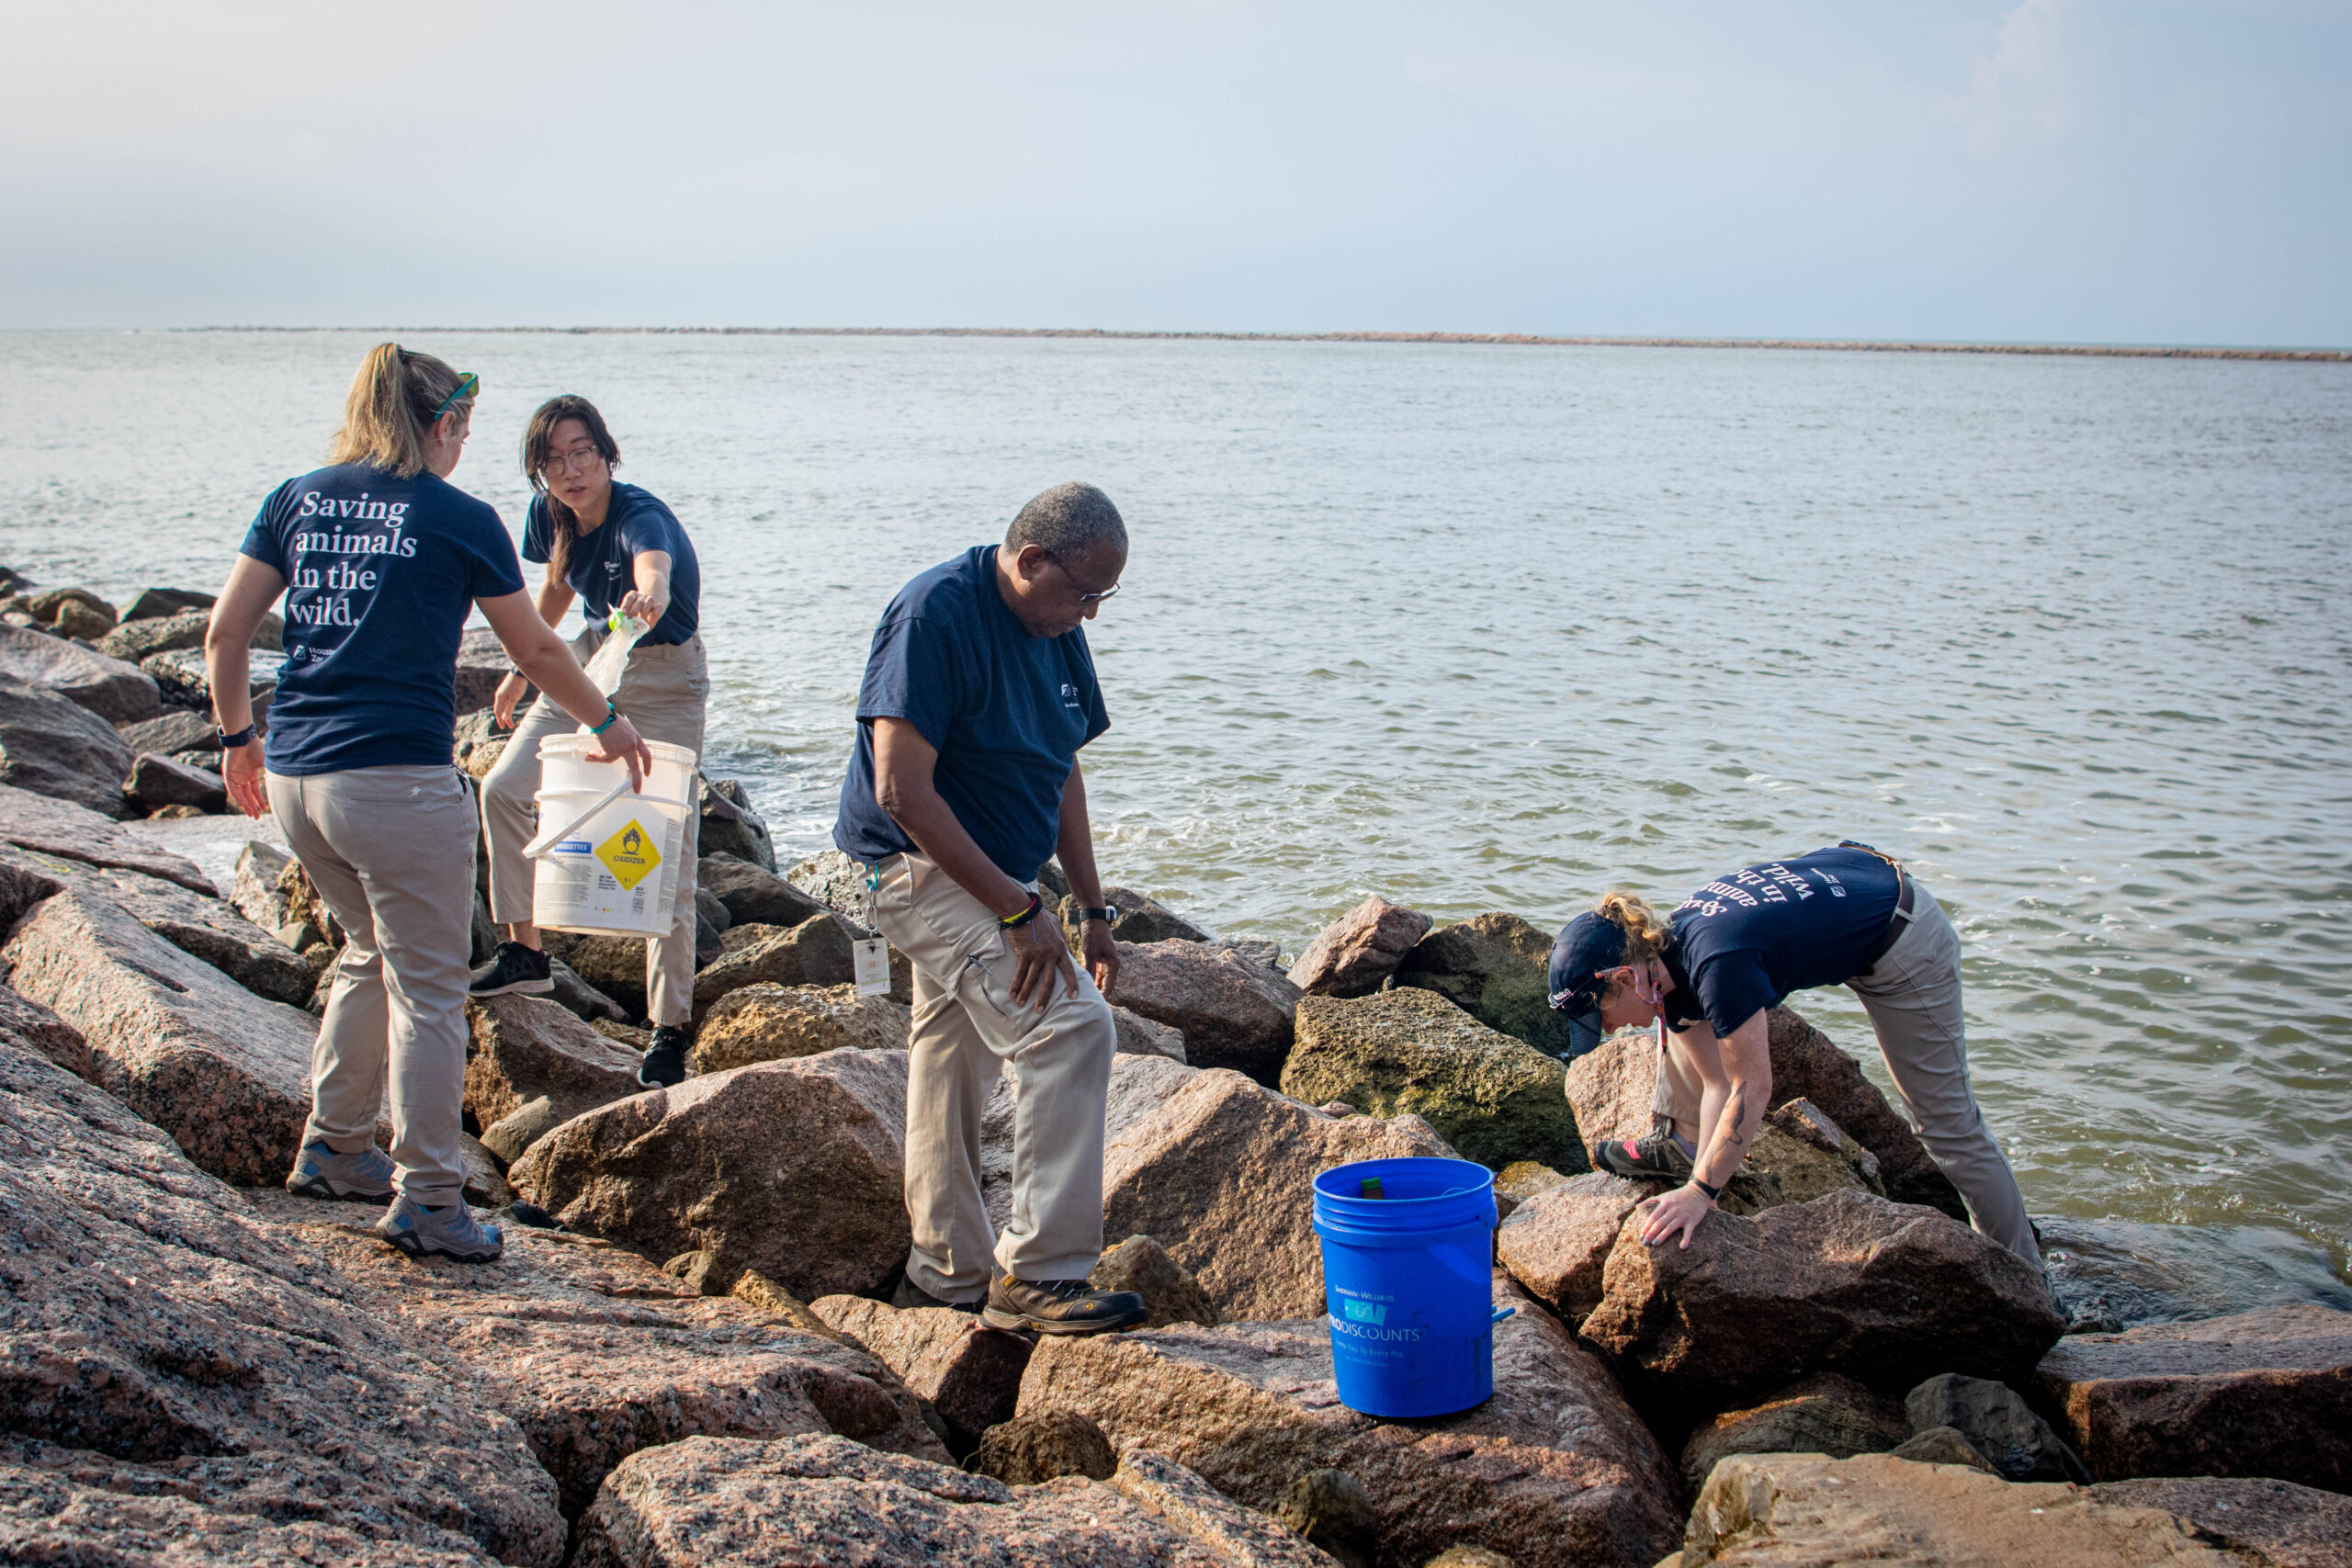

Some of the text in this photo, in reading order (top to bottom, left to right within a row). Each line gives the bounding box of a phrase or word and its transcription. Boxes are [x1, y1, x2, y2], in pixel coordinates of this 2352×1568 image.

[300, 491, 410, 528] Saving
[295, 525, 418, 558] animals
[293, 559, 377, 590] in the
[289, 595, 360, 626] wild.
[309, 647, 337, 656] Houst
[614, 855, 646, 864] OXIDIZER
[1700, 881, 1758, 908] anim
[1760, 863, 1815, 901] wild.
[1760, 884, 1788, 904] in
[1369, 1348, 1388, 1359] Every
